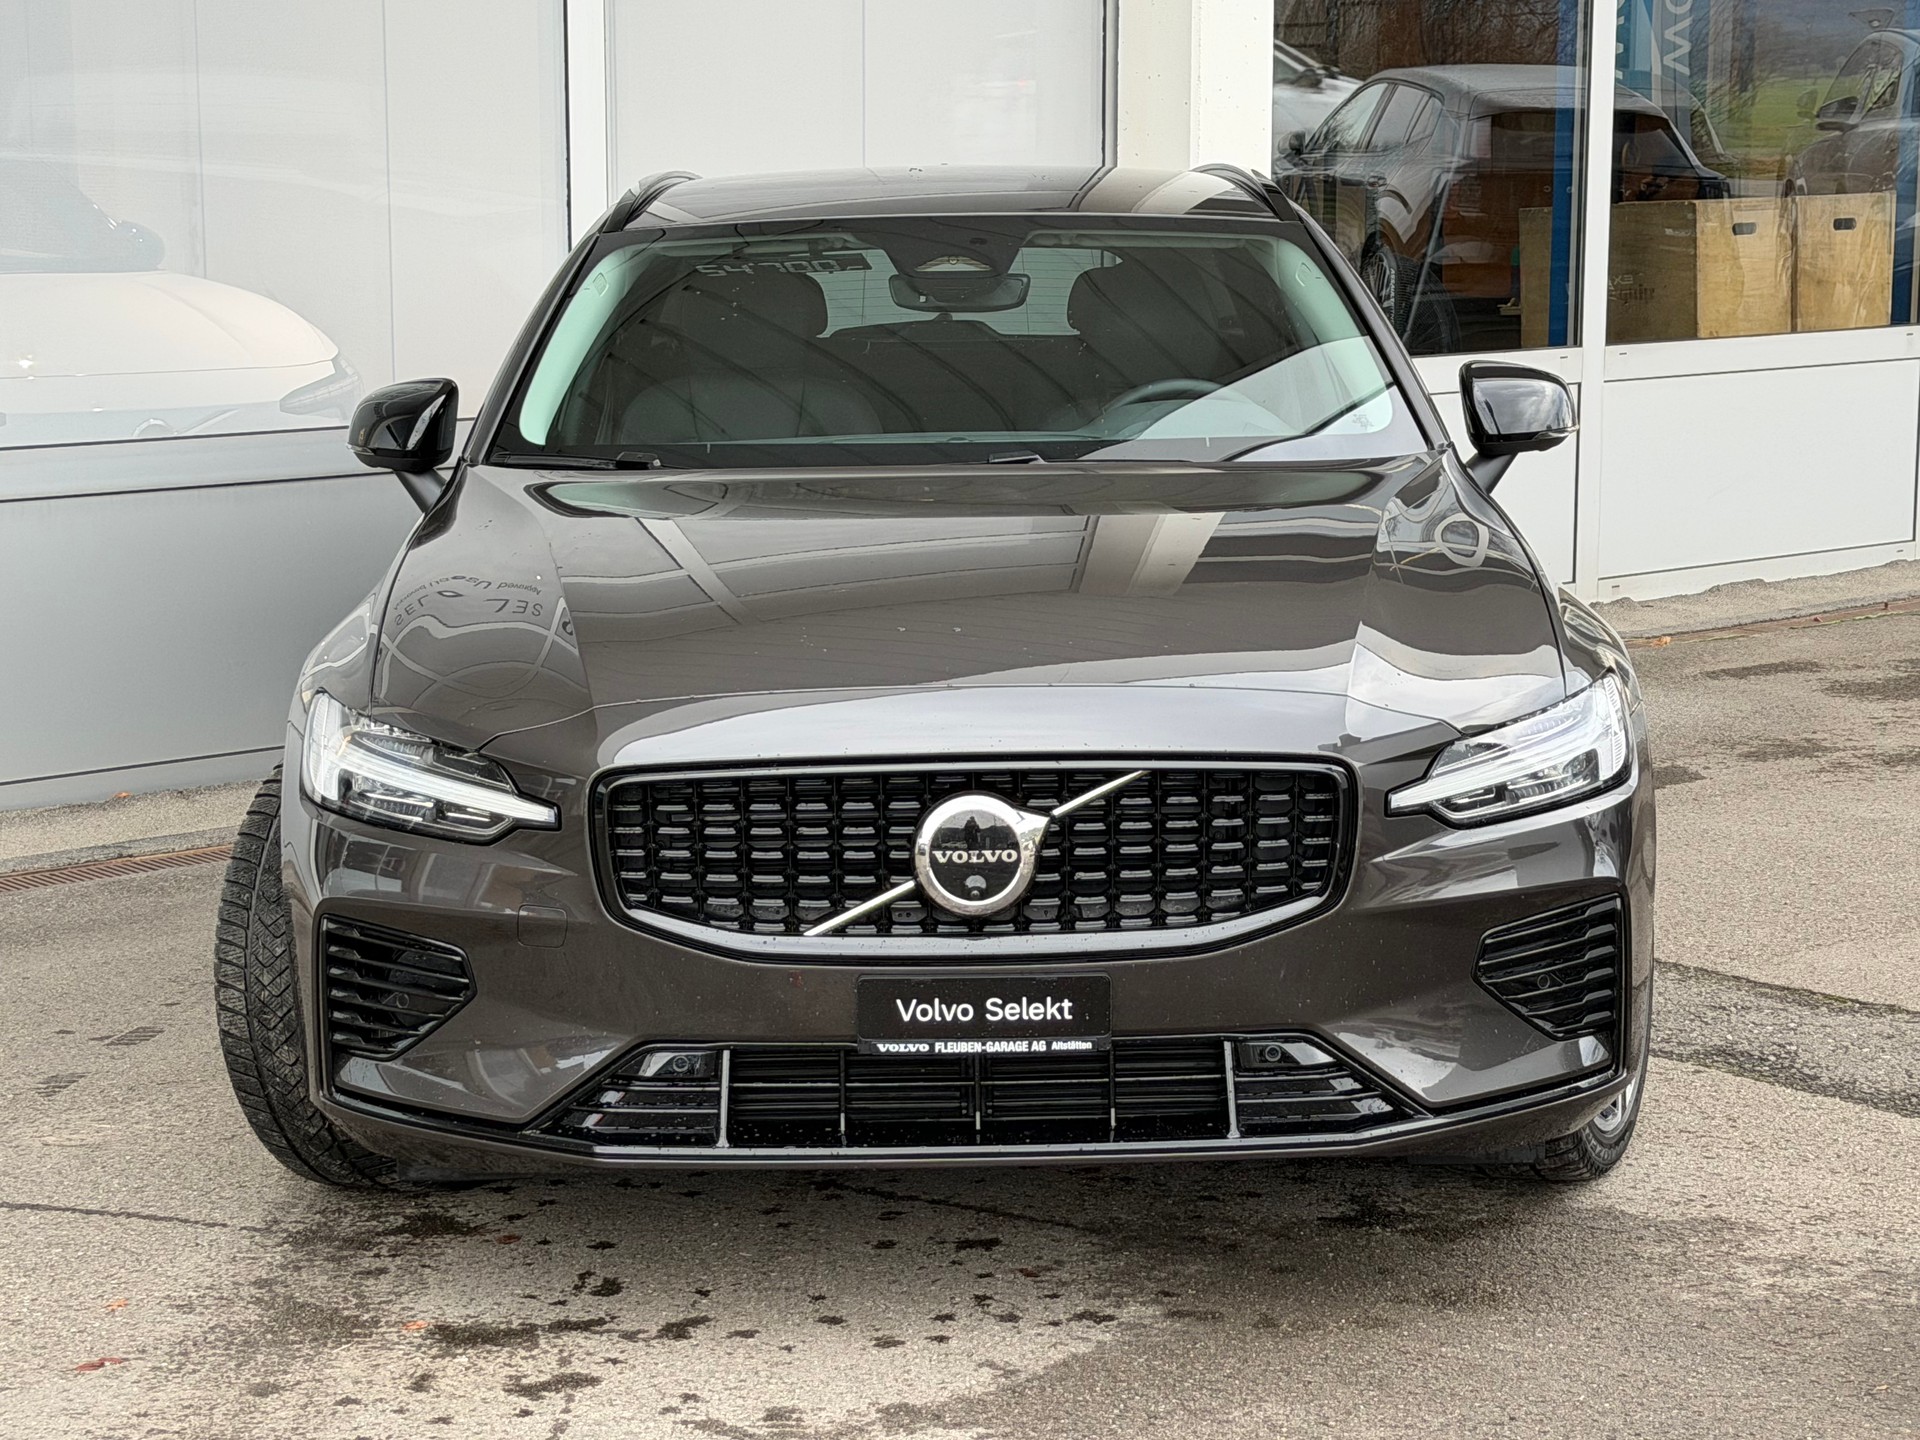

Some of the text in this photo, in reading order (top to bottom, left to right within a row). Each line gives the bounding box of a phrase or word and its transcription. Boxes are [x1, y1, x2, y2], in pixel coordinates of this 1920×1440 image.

[932, 849, 1018, 863] VOLVO
[896, 996, 1073, 1022] Volvo Selekt
[877, 1040, 1093, 1054] VOLVO FLEUBEN-GARAGE AG Altstätten
